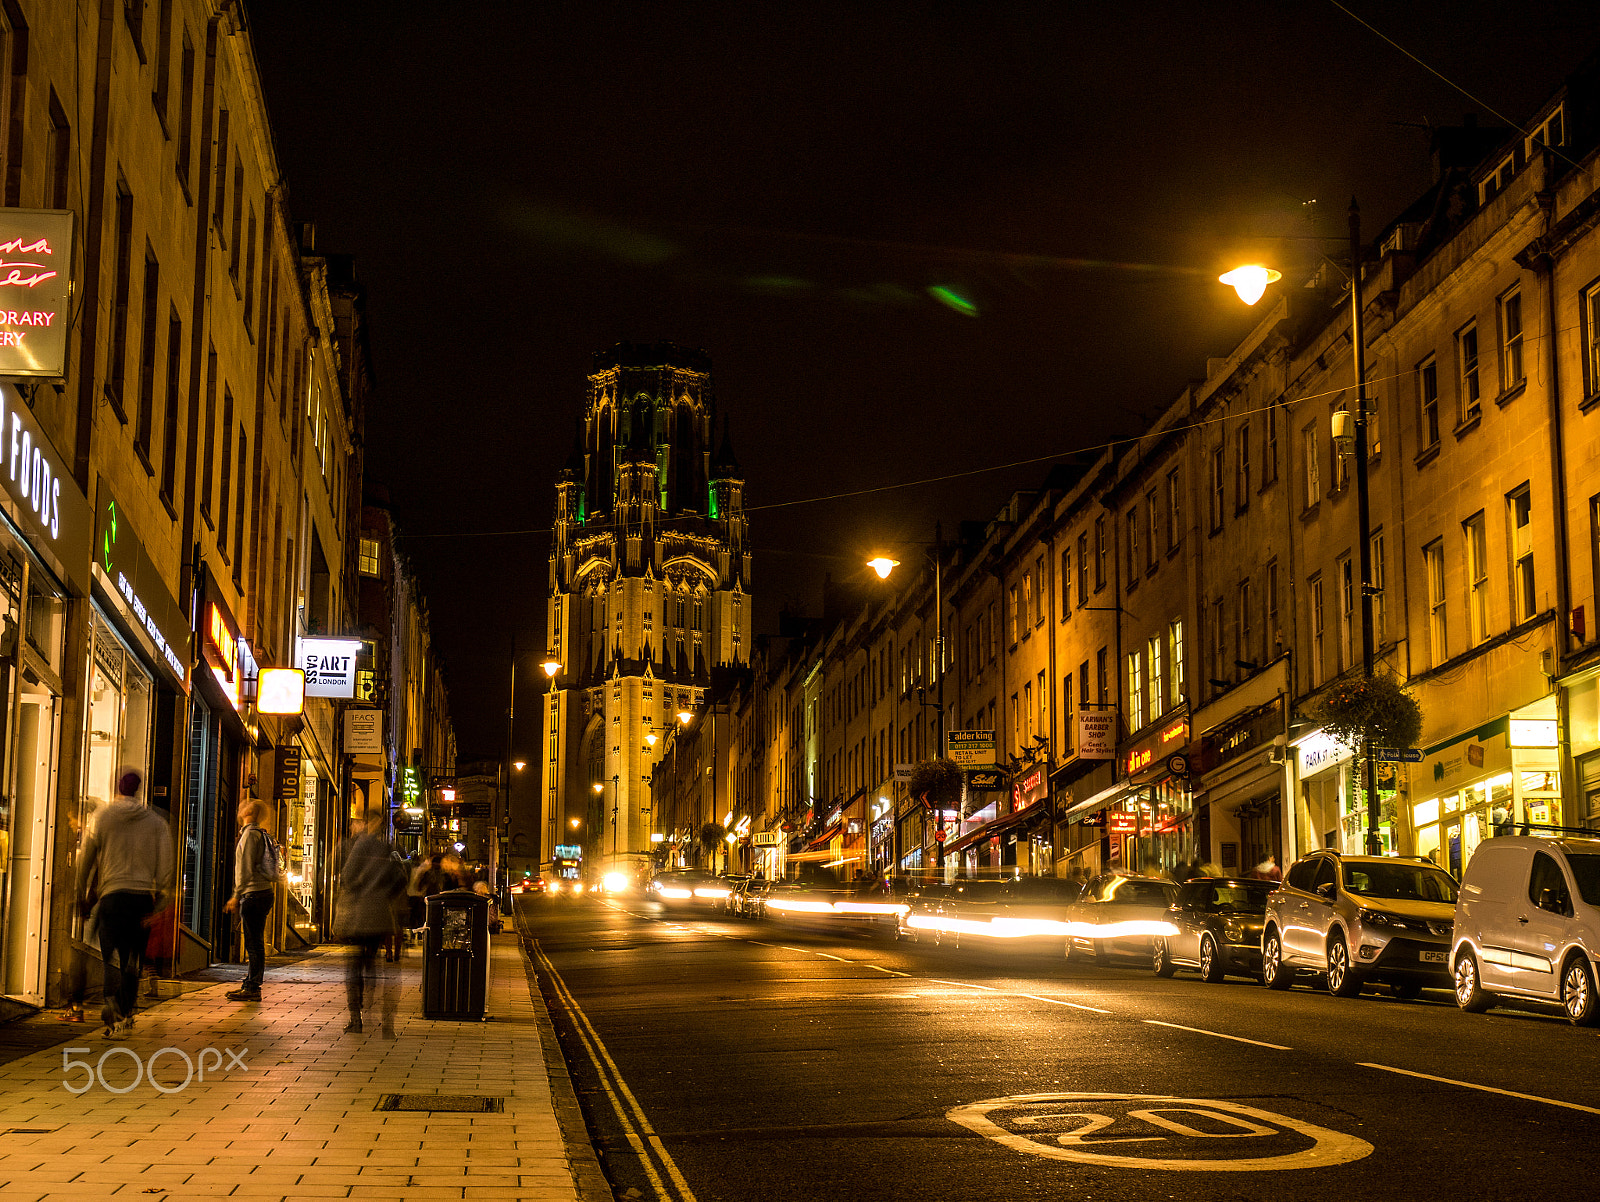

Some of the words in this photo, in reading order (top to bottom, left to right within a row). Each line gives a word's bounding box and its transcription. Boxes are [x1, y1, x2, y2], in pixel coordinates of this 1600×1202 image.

[10, 411, 60, 539] FOODS
[306, 655, 318, 684] CASS
[320, 655, 350, 671] ART
[318, 678, 347, 686] LONDON
[954, 731, 974, 740] alder
[976, 731, 993, 741] king
[1306, 751, 1321, 769] PARK
[1402, 750, 1419, 758] ouse
[1012, 1108, 1279, 1146] 20
